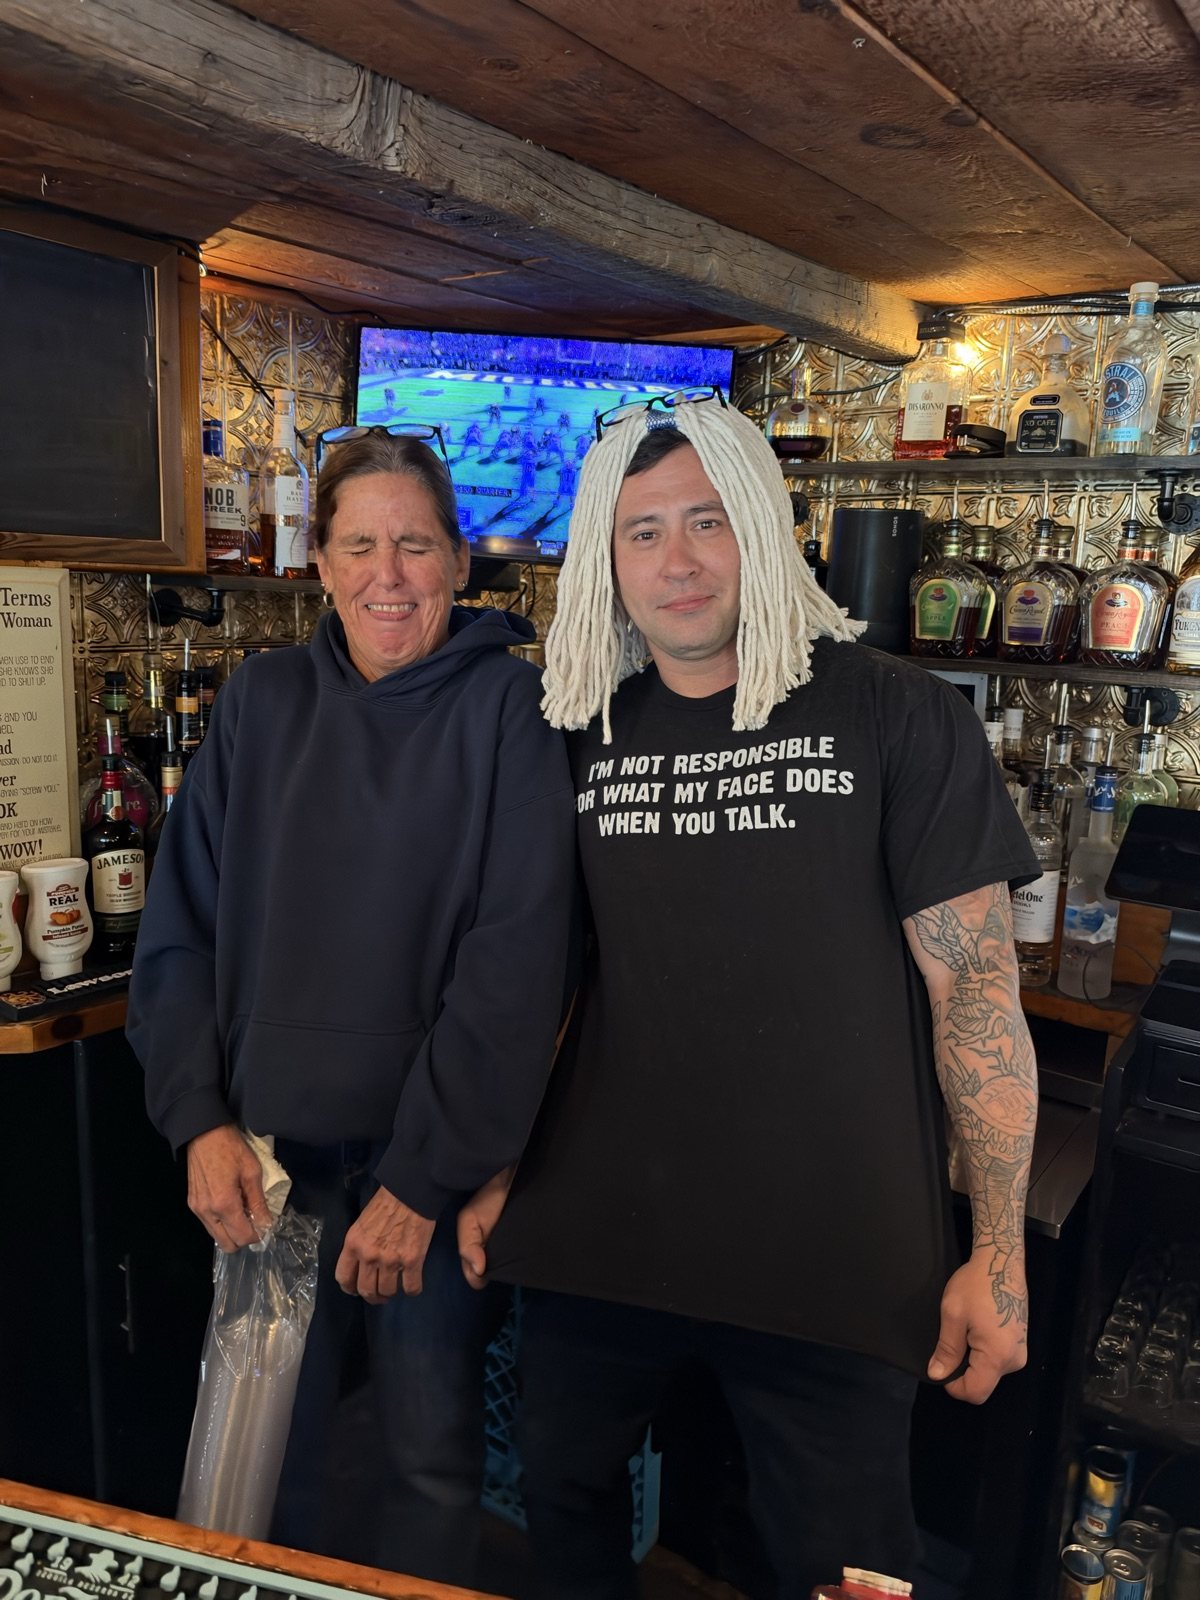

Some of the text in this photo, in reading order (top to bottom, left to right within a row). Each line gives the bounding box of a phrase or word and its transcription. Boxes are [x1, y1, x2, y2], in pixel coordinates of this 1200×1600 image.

[908, 402, 944, 411] DISARONNO
[240, 514, 246, 527] 9
[0, 587, 51, 607] Terms
[0, 611, 53, 629] Woman
[588, 736, 835, 782] I'M NOT RESPONSIBLE
[575, 768, 854, 814] OR WHAT MY FACE DOES
[598, 803, 796, 837] WHEN YOU TALK.
[0, 839, 42, 860] WOW!
[51, 1556, 73, 1571] 19
